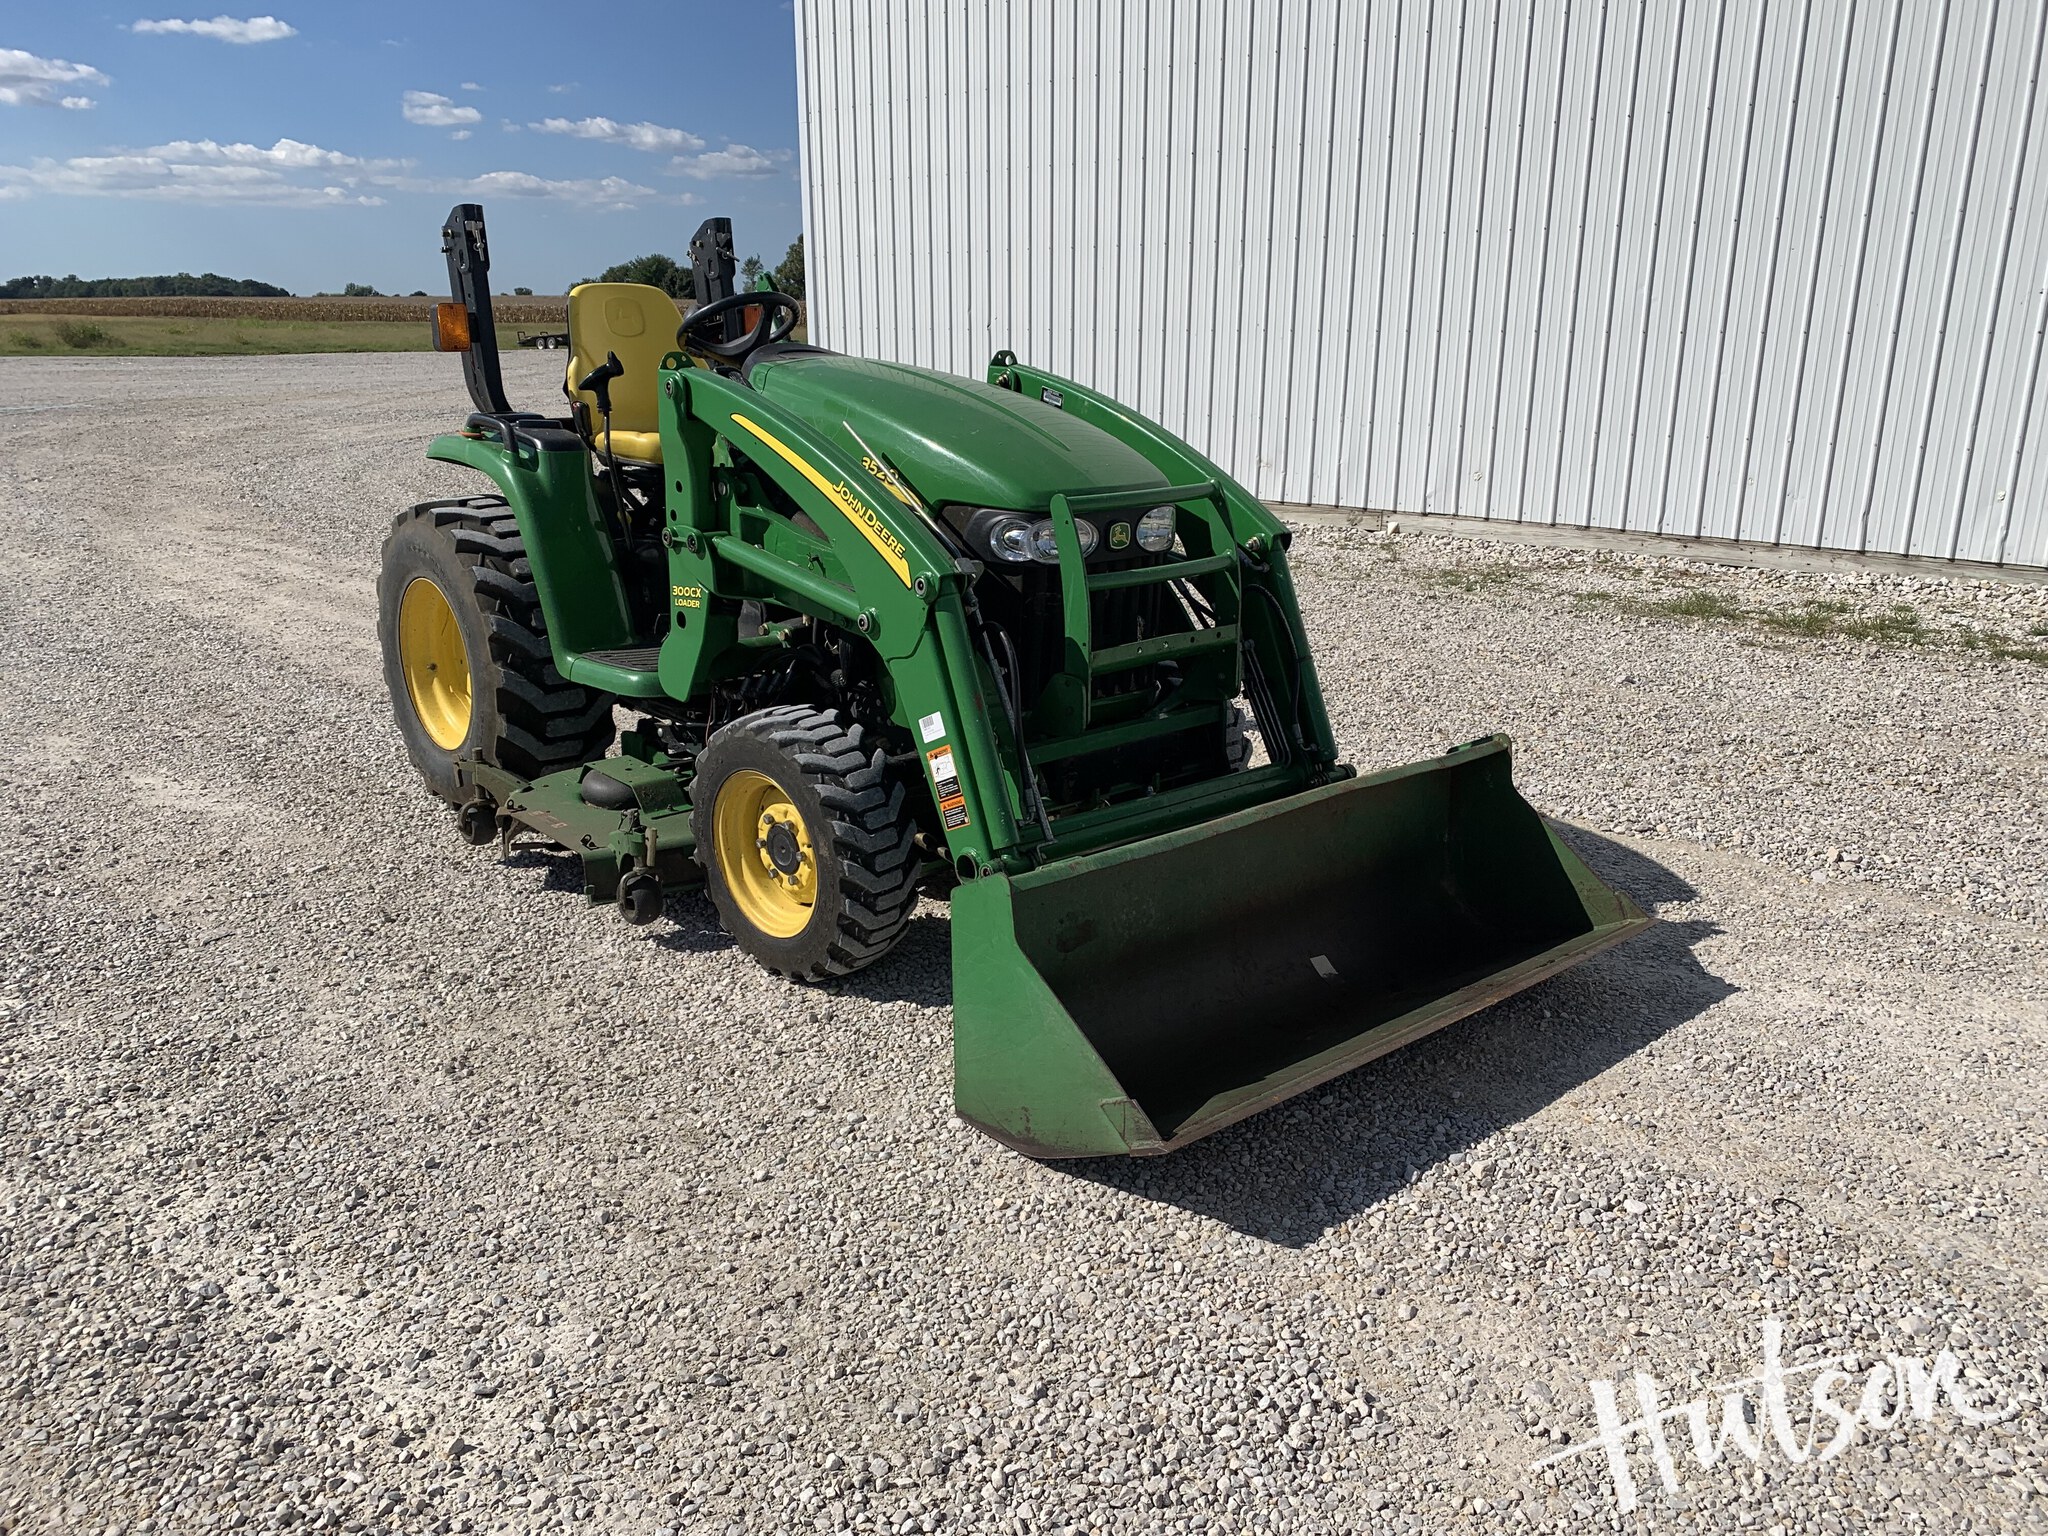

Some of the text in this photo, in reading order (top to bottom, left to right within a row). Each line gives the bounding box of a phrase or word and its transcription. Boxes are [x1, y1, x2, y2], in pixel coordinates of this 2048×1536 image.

[832, 480, 906, 559] JOHN DEERE
[672, 585, 702, 609] 300CX LOADER
